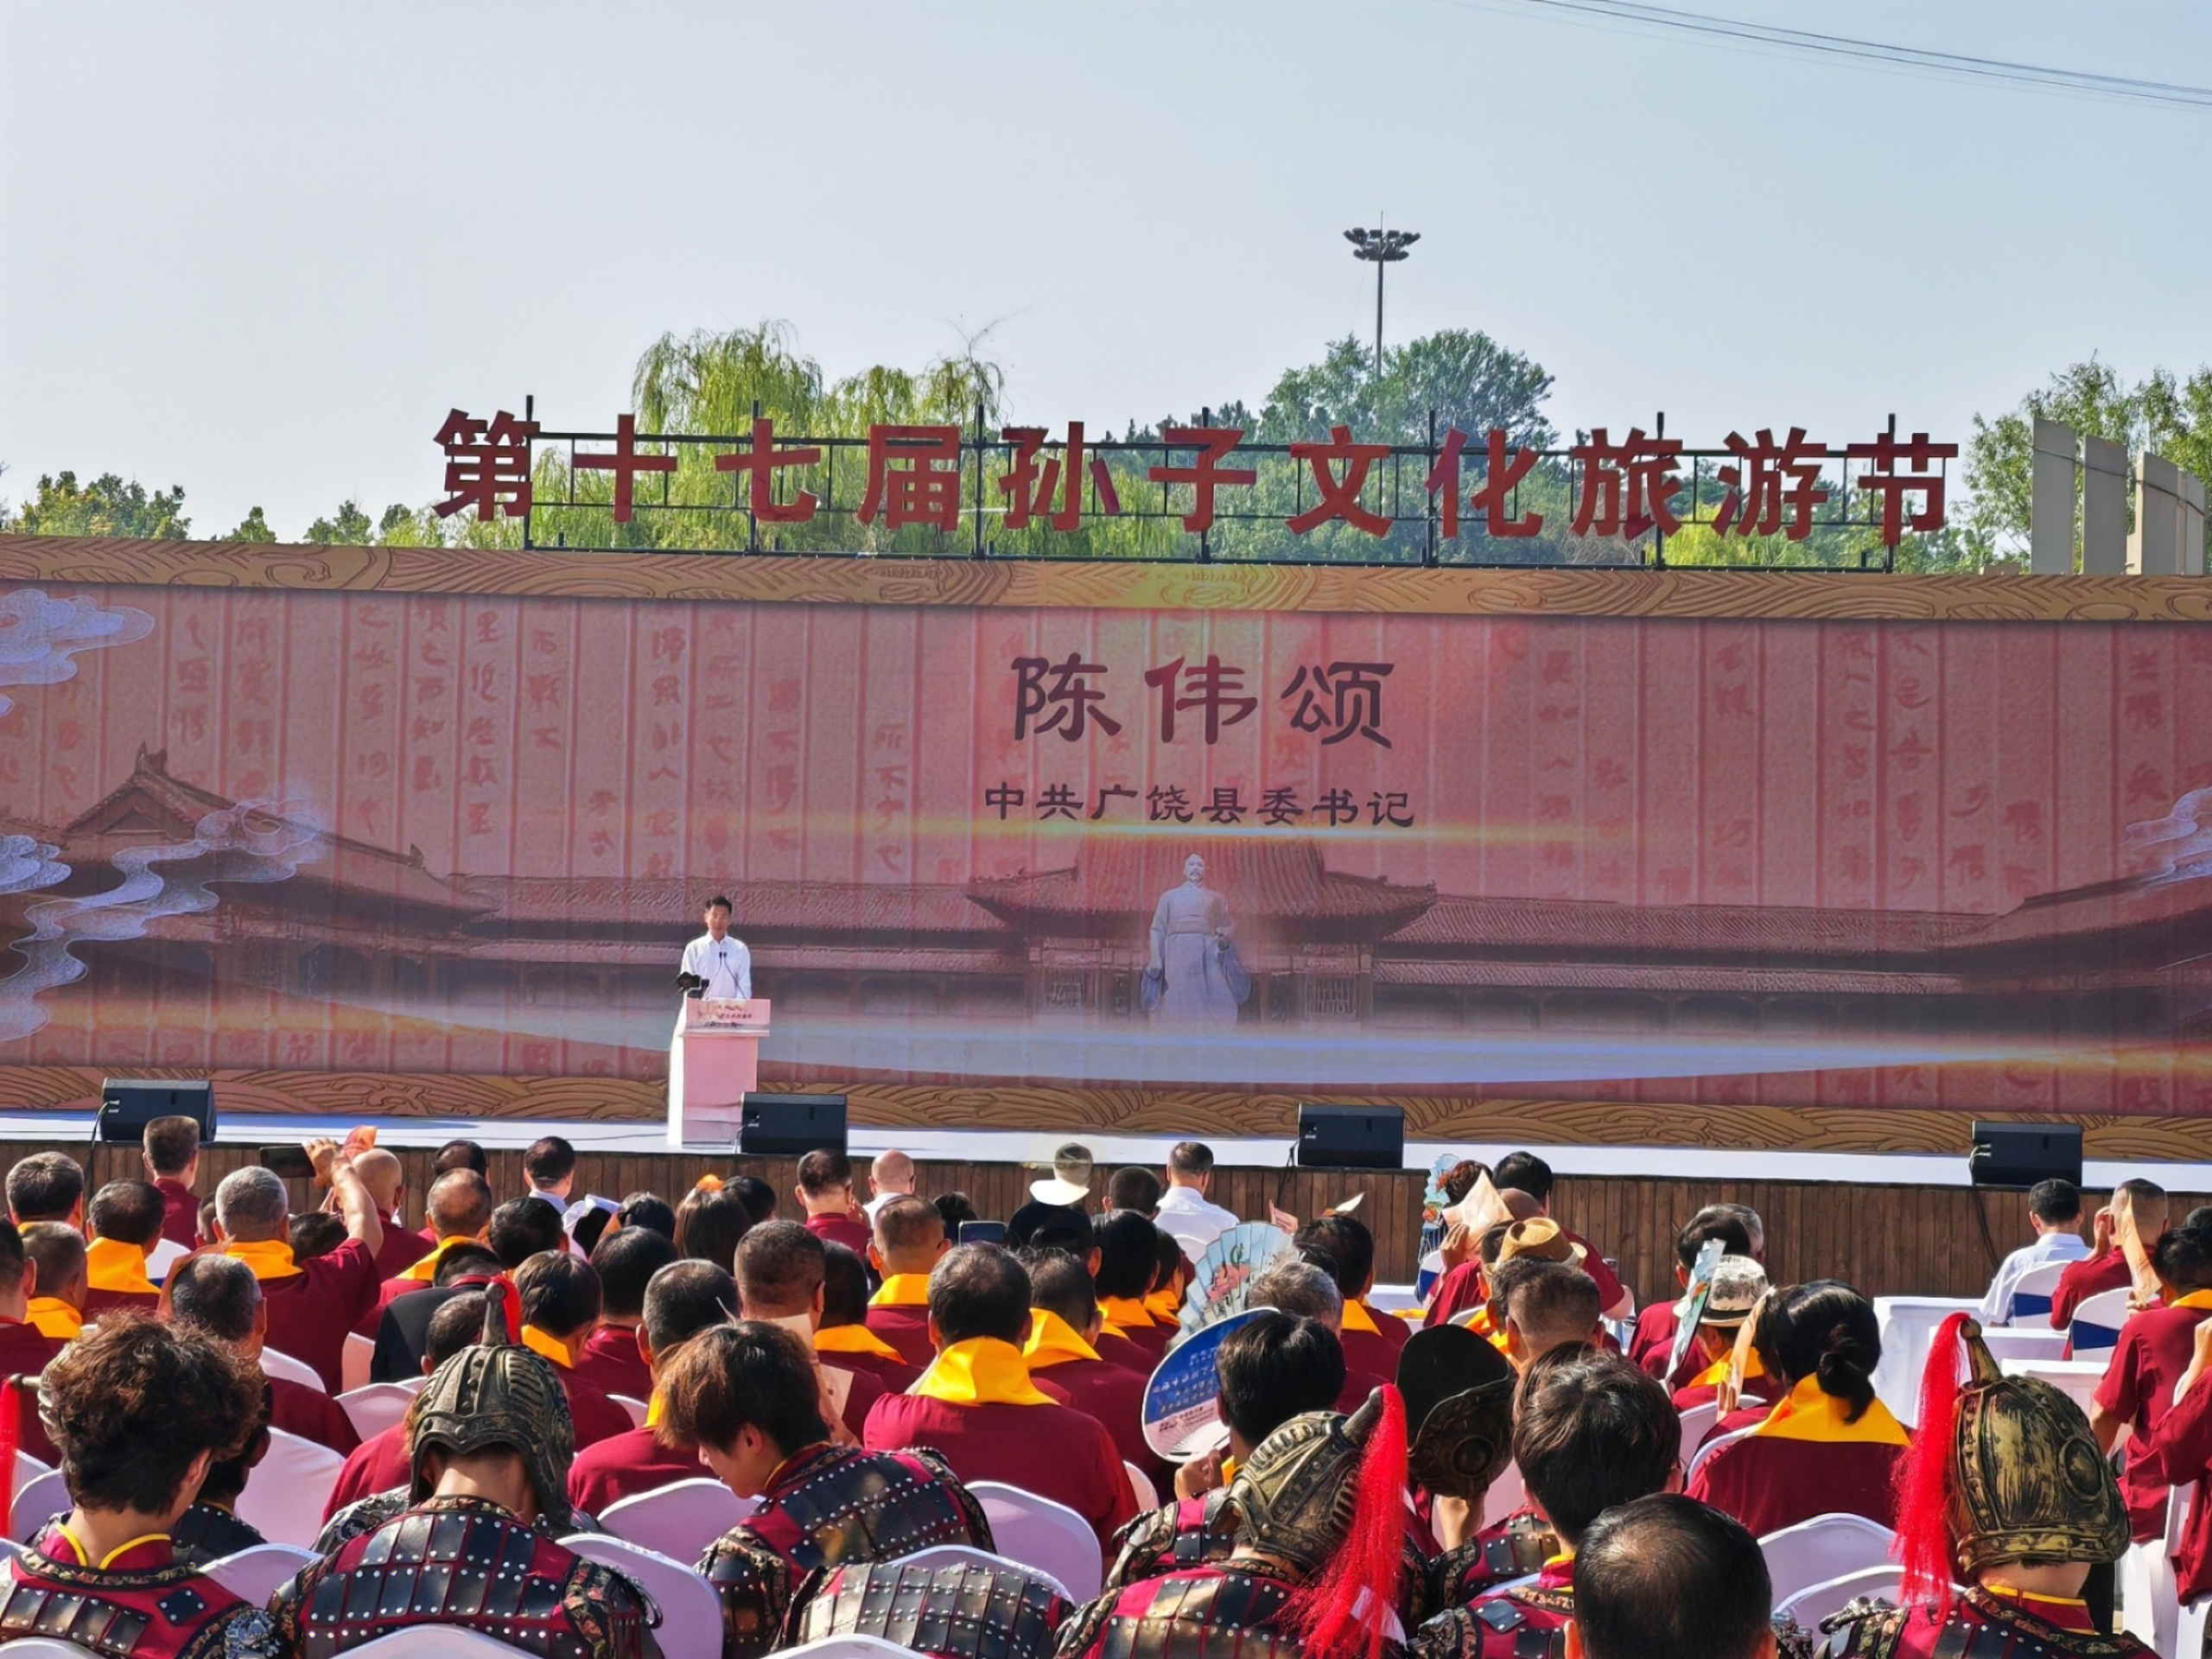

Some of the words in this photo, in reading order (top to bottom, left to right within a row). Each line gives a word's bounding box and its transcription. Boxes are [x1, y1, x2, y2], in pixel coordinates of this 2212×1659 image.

[433, 408, 1959, 545] 第十七届孙子文化旅游节
[1010, 652, 1395, 749] 陈伟颂
[985, 781, 1415, 828] 中共广饶县委书记
